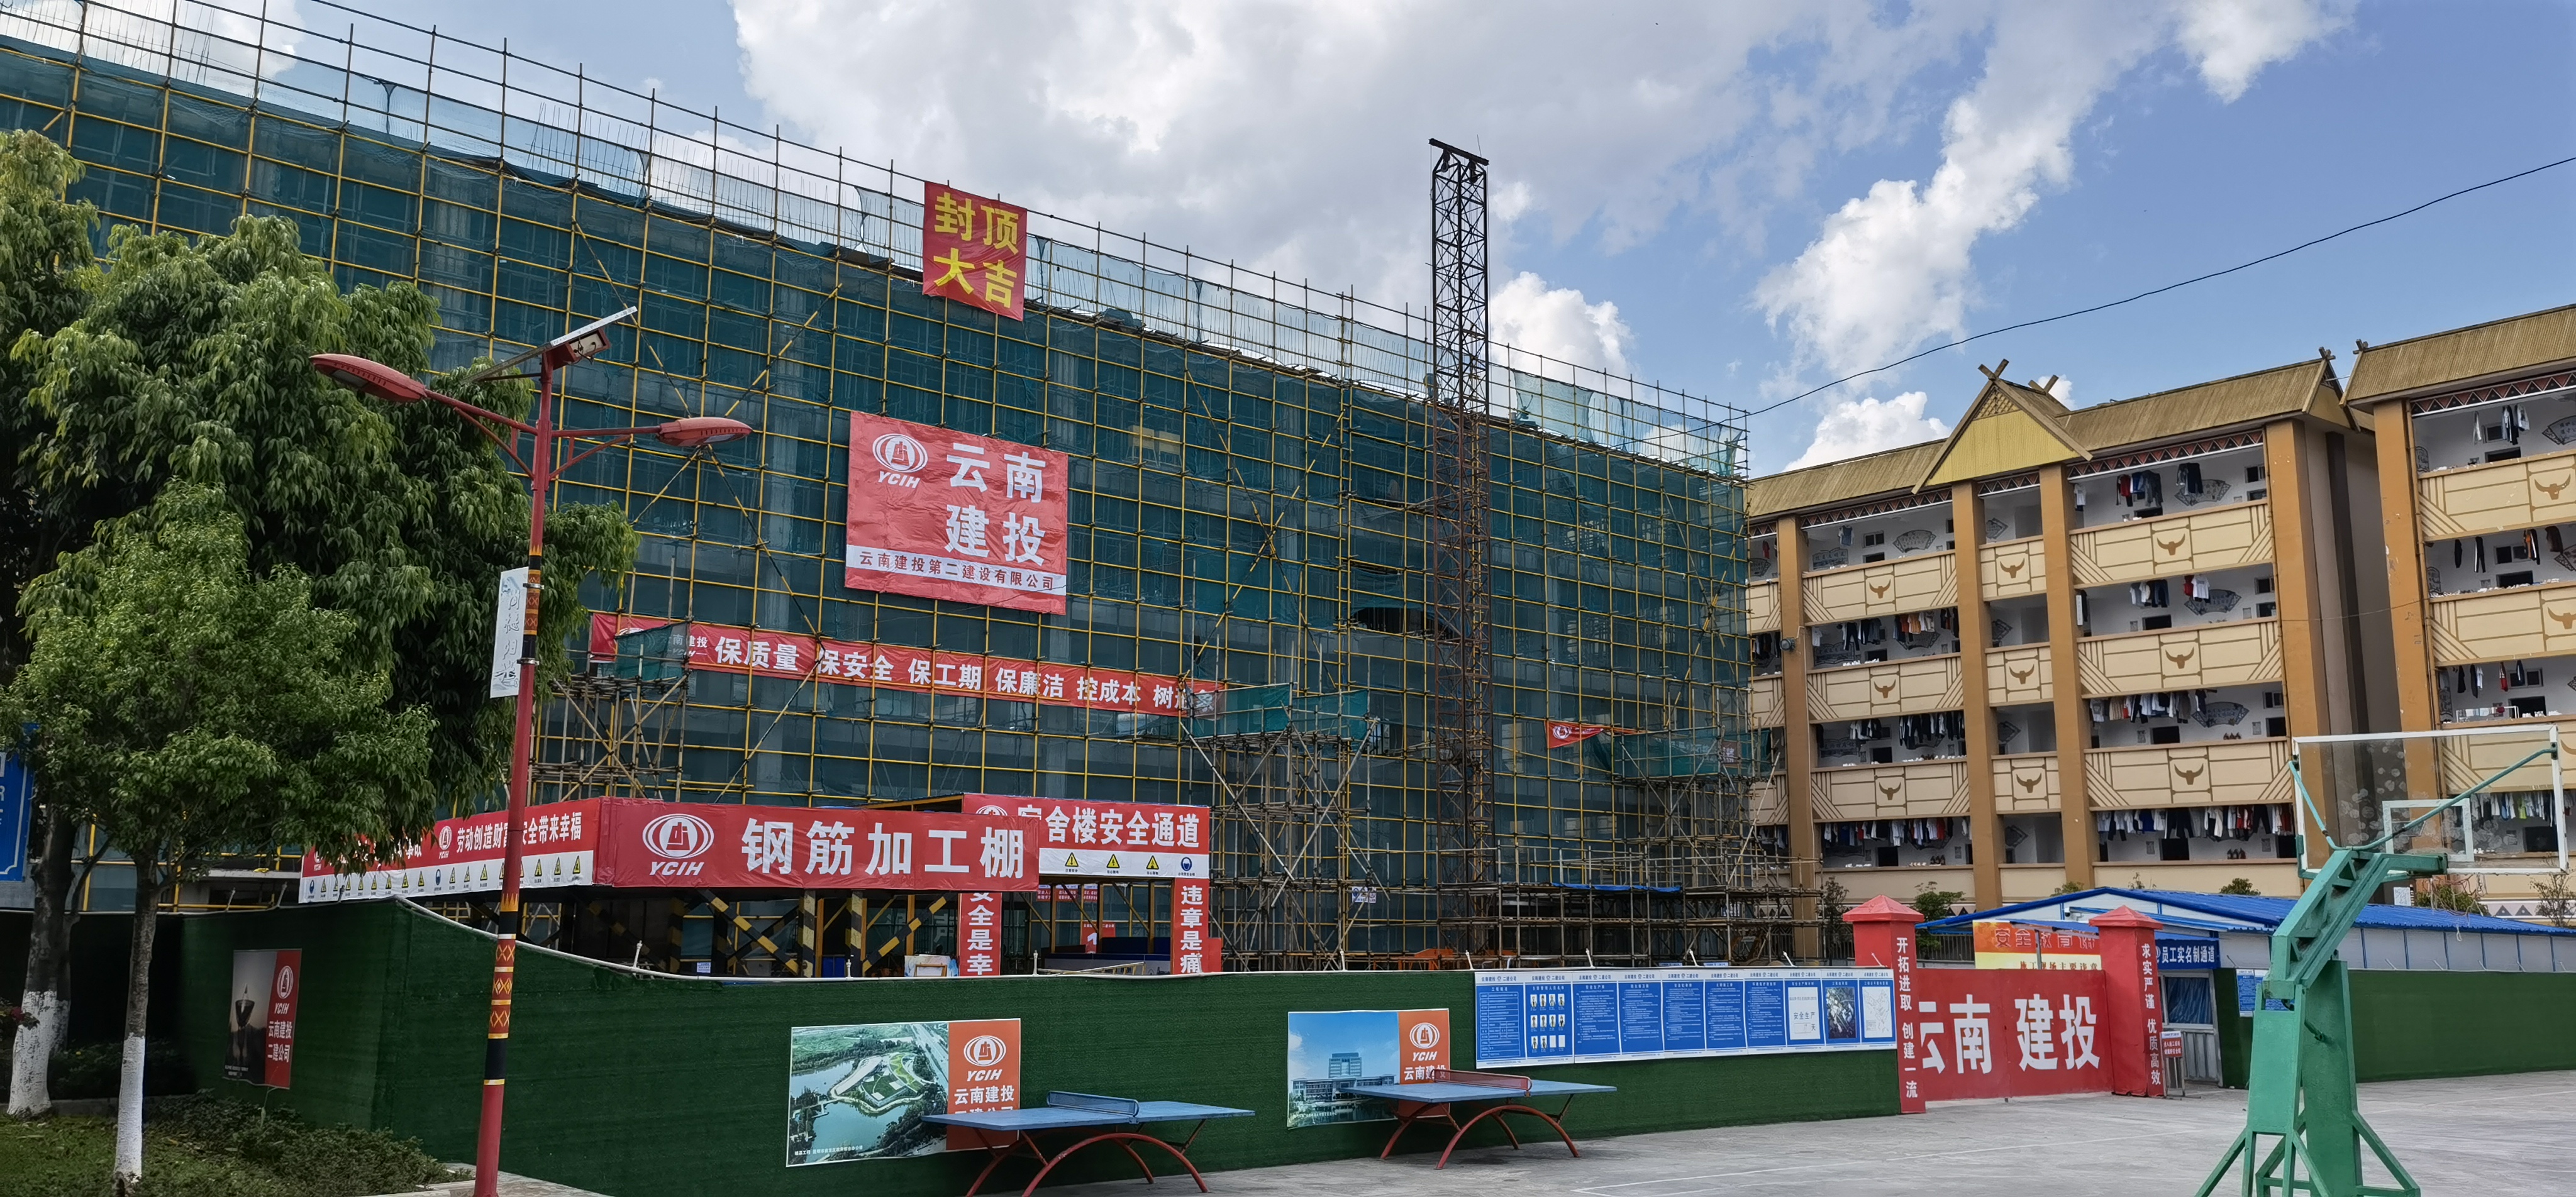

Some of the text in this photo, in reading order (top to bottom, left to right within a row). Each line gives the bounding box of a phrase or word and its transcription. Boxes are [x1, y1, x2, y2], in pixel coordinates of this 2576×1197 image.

[935, 192, 1019, 255] 封顶
[934, 246, 1017, 309] 大吉
[877, 470, 921, 489] YCIH
[947, 443, 1046, 504] 云南
[945, 504, 1045, 566] 建投
[859, 551, 1055, 590] 云南建投第二建设有限公司
[714, 636, 800, 671] 保质量
[816, 649, 894, 682] 保安全
[908, 658, 983, 692] 保工期
[994, 667, 1065, 698] 保廉洁
[1076, 675, 1141, 706] 控成本
[741, 816, 1024, 880] 钢筋加工棚
[650, 860, 705, 876] YCIH
[1180, 885, 1204, 974] 违章是痛
[2162, 945, 2215, 964] 员工实名制通道
[274, 1002, 289, 1015] YCIH
[1793, 1011, 1816, 1020] 安全生产
[1896, 937, 1918, 1100] 开拓进取 创建一流
[2141, 943, 2162, 1086] 求实严谨 优质高效
[268, 1020, 292, 1039] 云南建投
[1919, 993, 2101, 1075] 云南 建投
[267, 1044, 291, 1062] 二建公司
[1412, 1051, 1438, 1062] YCIH
[953, 1084, 1015, 1106] 云南建投
[966, 1068, 1003, 1083] YCIH
